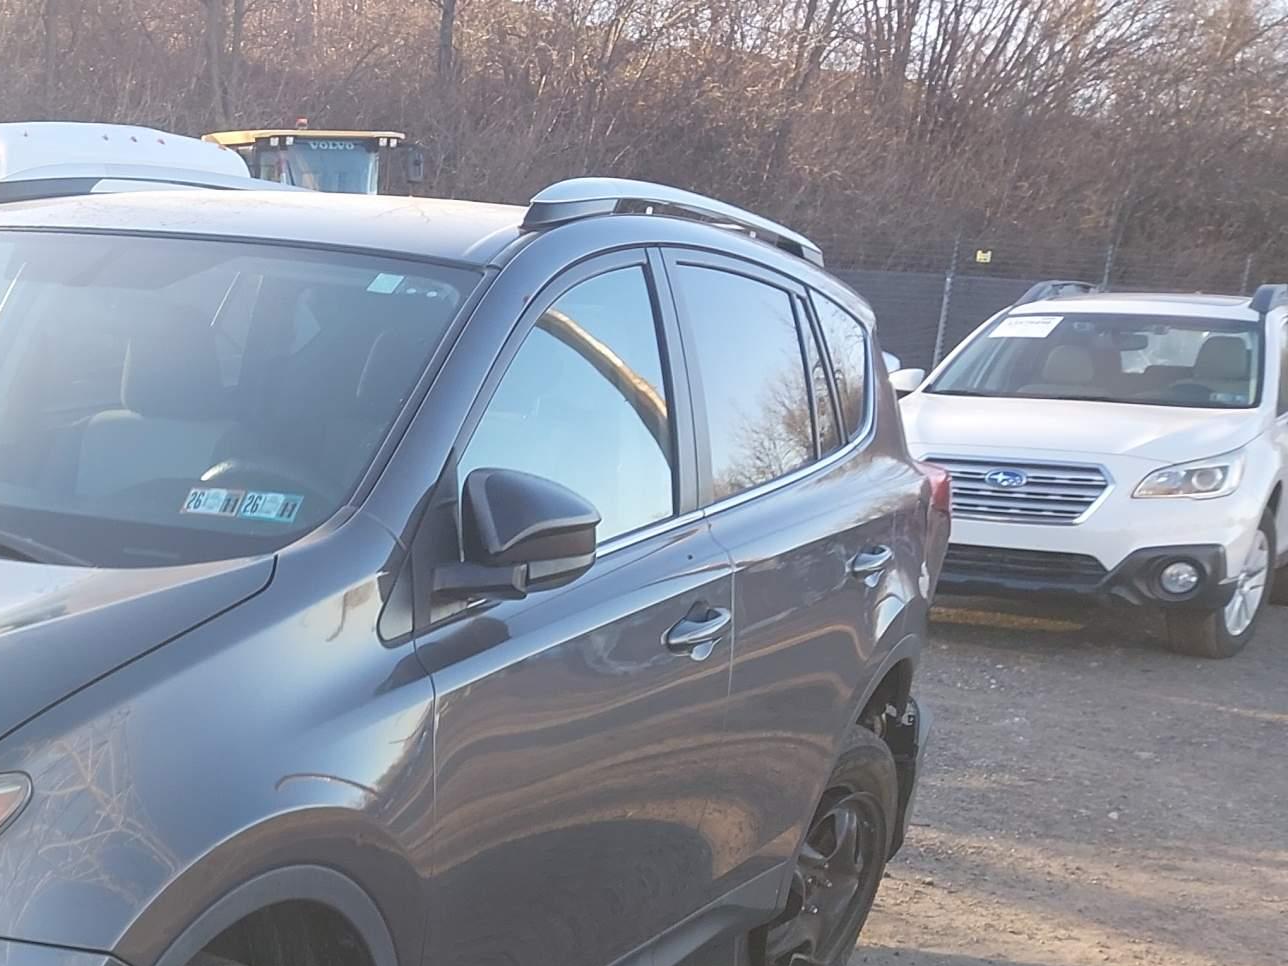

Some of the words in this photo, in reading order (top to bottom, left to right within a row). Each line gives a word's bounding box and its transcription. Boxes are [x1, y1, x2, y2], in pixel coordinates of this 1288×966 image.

[310, 141, 355, 150] VOLVO
[186, 491, 205, 509] 26
[242, 494, 262, 513] 26
